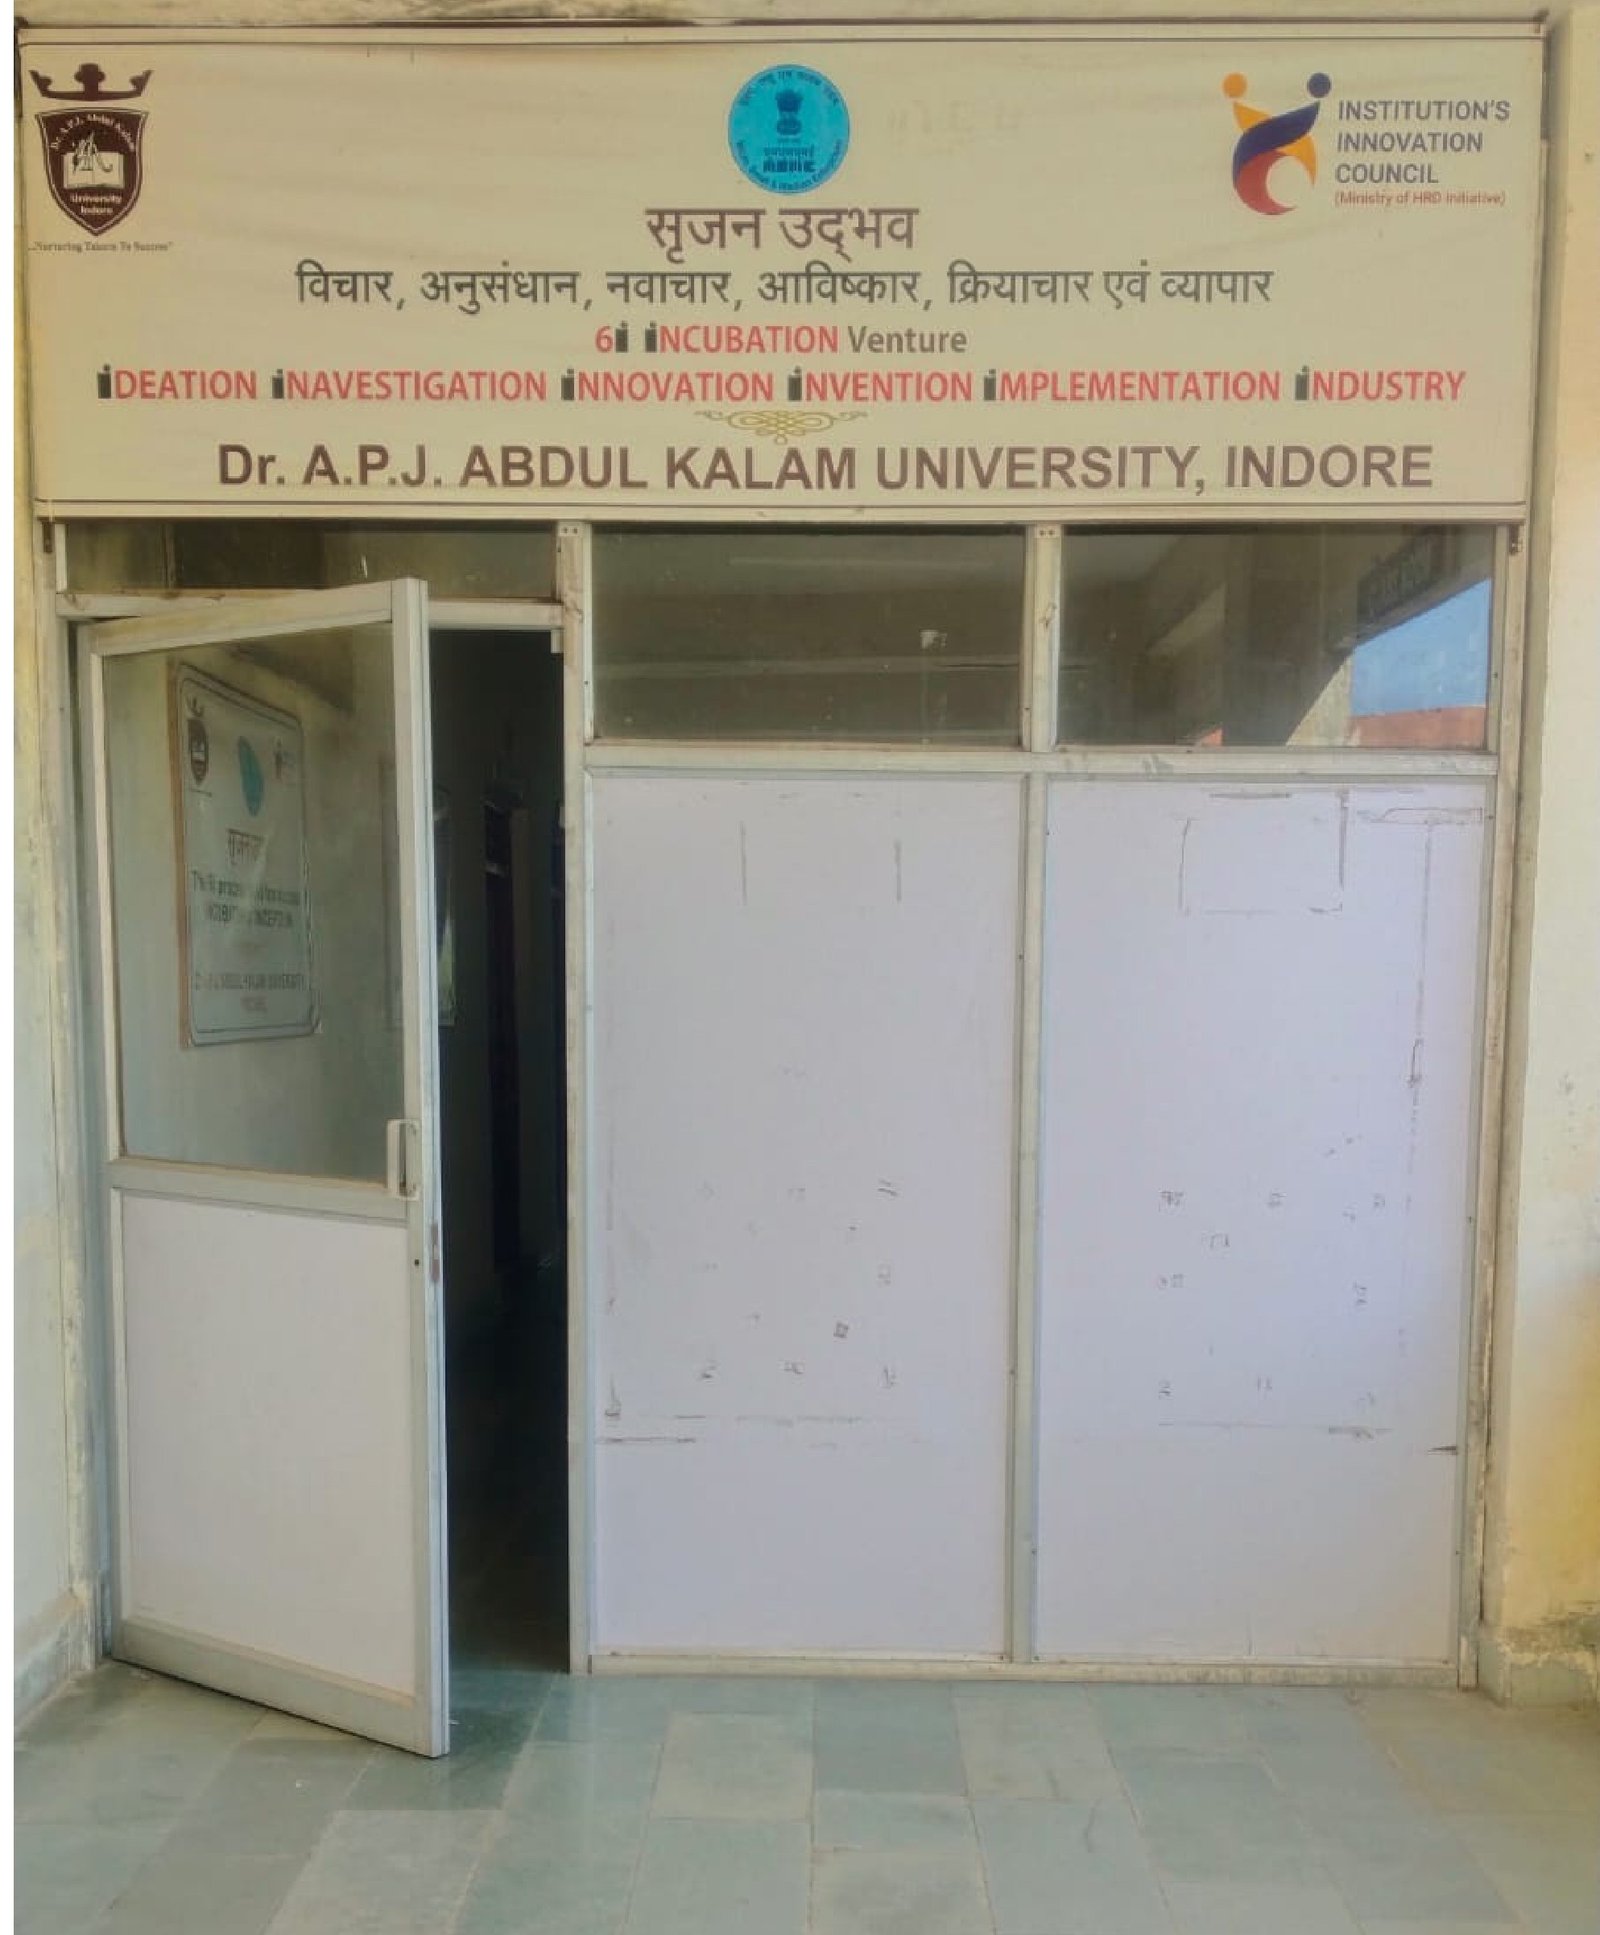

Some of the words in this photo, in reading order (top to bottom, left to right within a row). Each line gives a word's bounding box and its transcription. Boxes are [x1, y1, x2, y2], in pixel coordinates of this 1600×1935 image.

[1338, 100, 1511, 122] INSTITUTION'S
[1337, 131, 1483, 153] INNOVATION
[1335, 163, 1439, 184] COUNCIL
[1334, 190, 1393, 208] (Ministry
[1396, 191, 1411, 205] of
[1413, 192, 1442, 205] HRD
[1446, 191, 1506, 207] Initiative)
[645, 208, 767, 264] सृजन
[294, 259, 405, 311] विचार,
[420, 260, 593, 315] अनुसंधान,
[605, 271, 742, 312] नवाचार,
[757, 259, 932, 312] आविष्कार,
[947, 259, 1094, 304] क्रियाचार
[1102, 259, 1152, 310] एवं
[1160, 270, 1275, 304] व्यापार
[848, 326, 968, 354] Venture
[218, 444, 286, 486] Dr.
[301, 444, 442, 489] A.P.J.
[459, 446, 649, 489] ABDUL
[667, 446, 856, 490] KALAM
[877, 446, 1204, 496] UNIVERSITY,
[1226, 445, 1433, 488] INDORE
